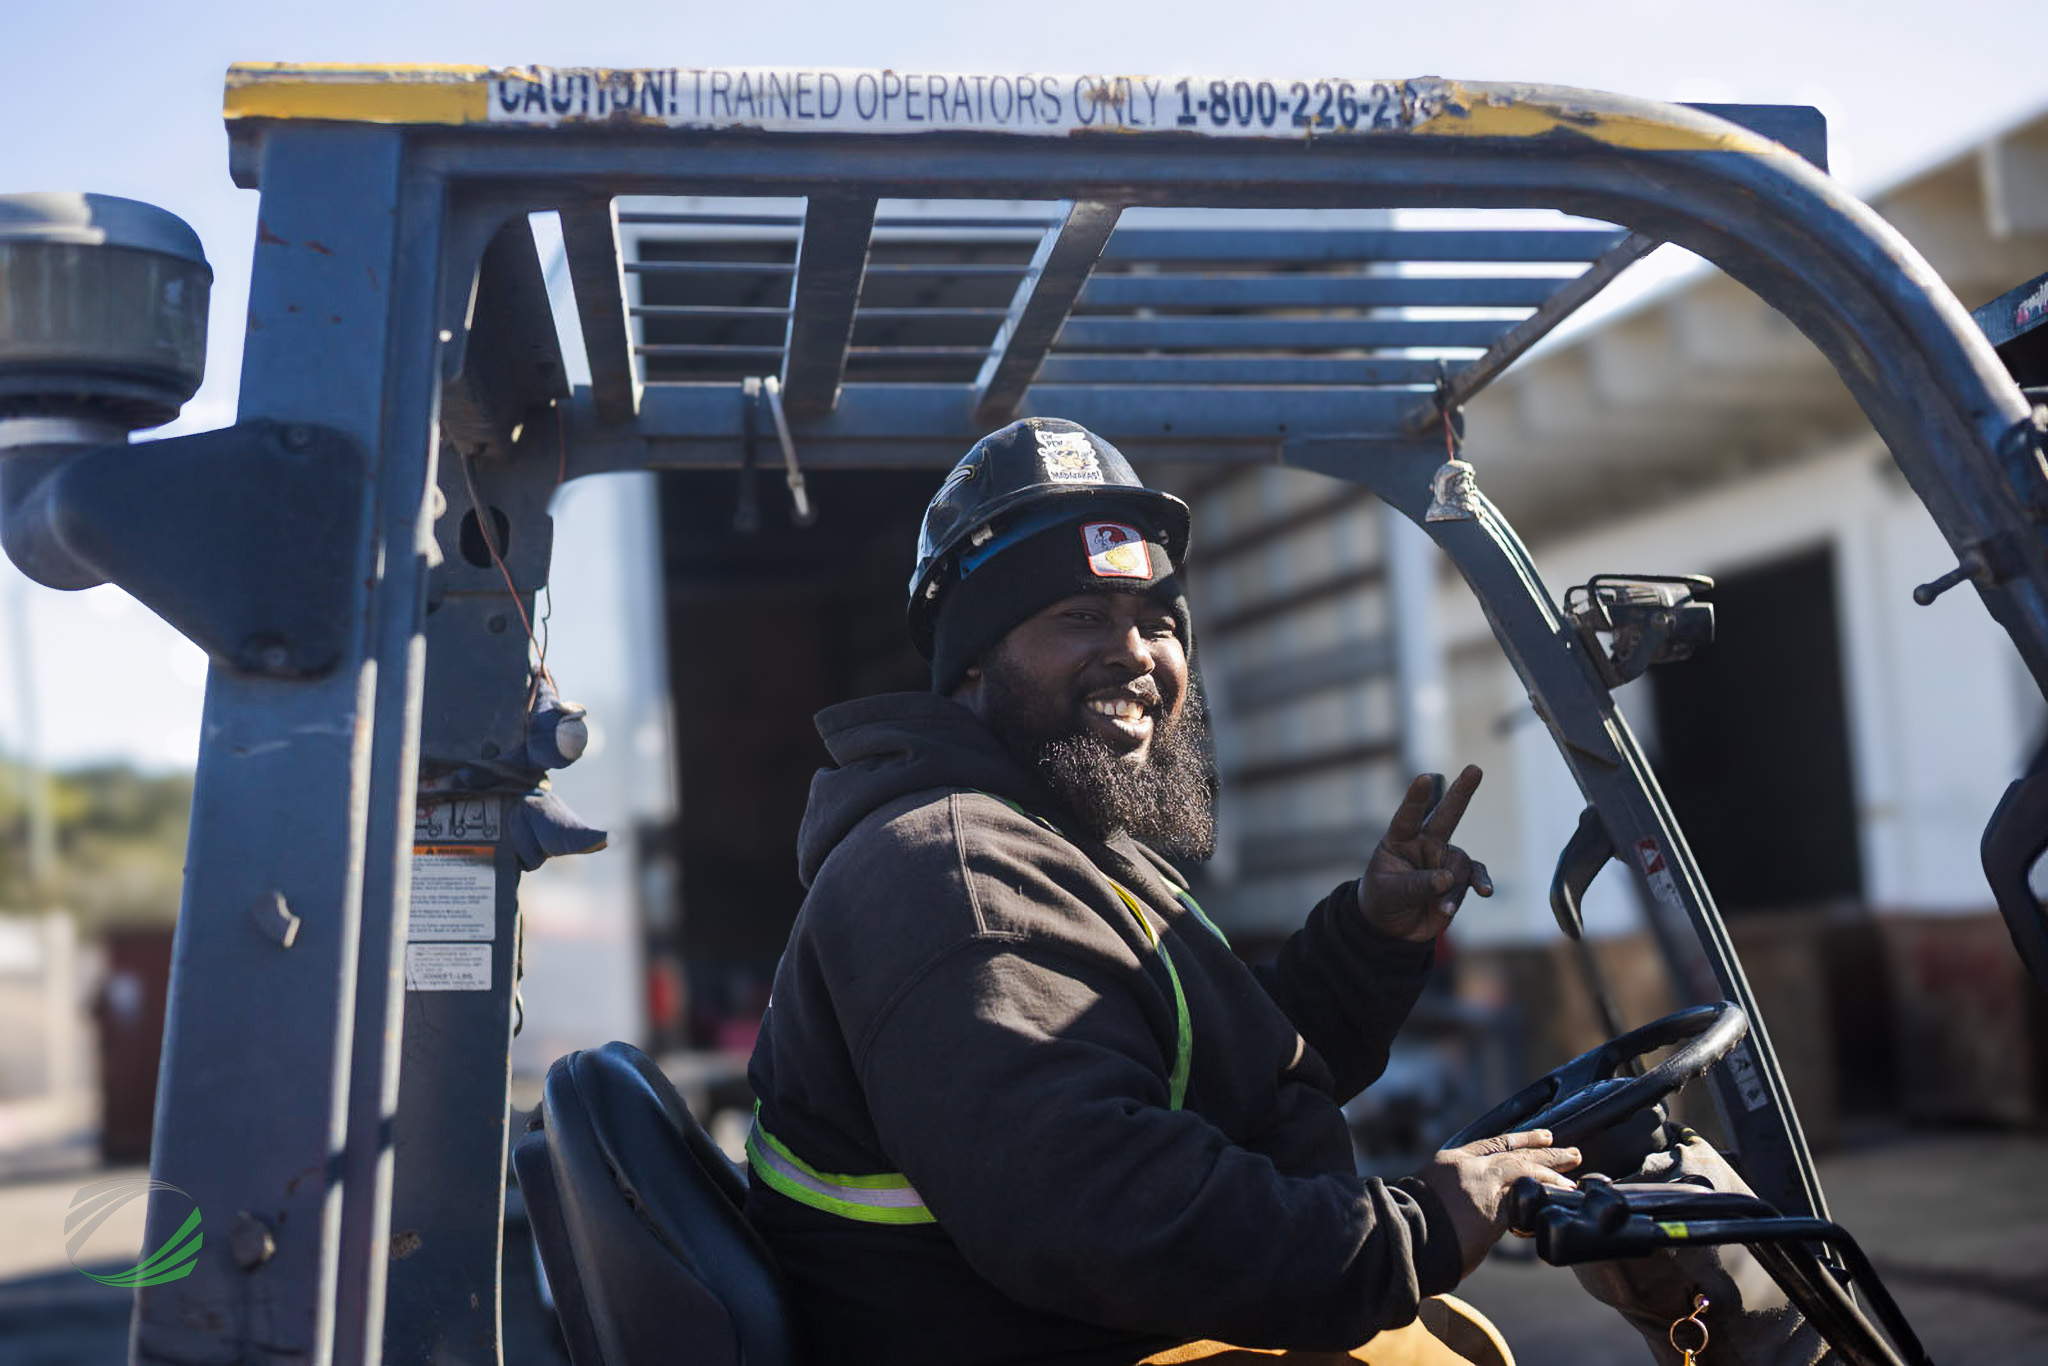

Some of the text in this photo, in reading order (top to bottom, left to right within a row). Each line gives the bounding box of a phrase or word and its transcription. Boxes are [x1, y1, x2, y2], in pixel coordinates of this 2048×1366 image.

[499, 71, 677, 115] CAUTION!
[694, 69, 842, 120] TRAINED
[855, 73, 1062, 124] OPERATORS
[1074, 75, 1160, 126] ONLY
